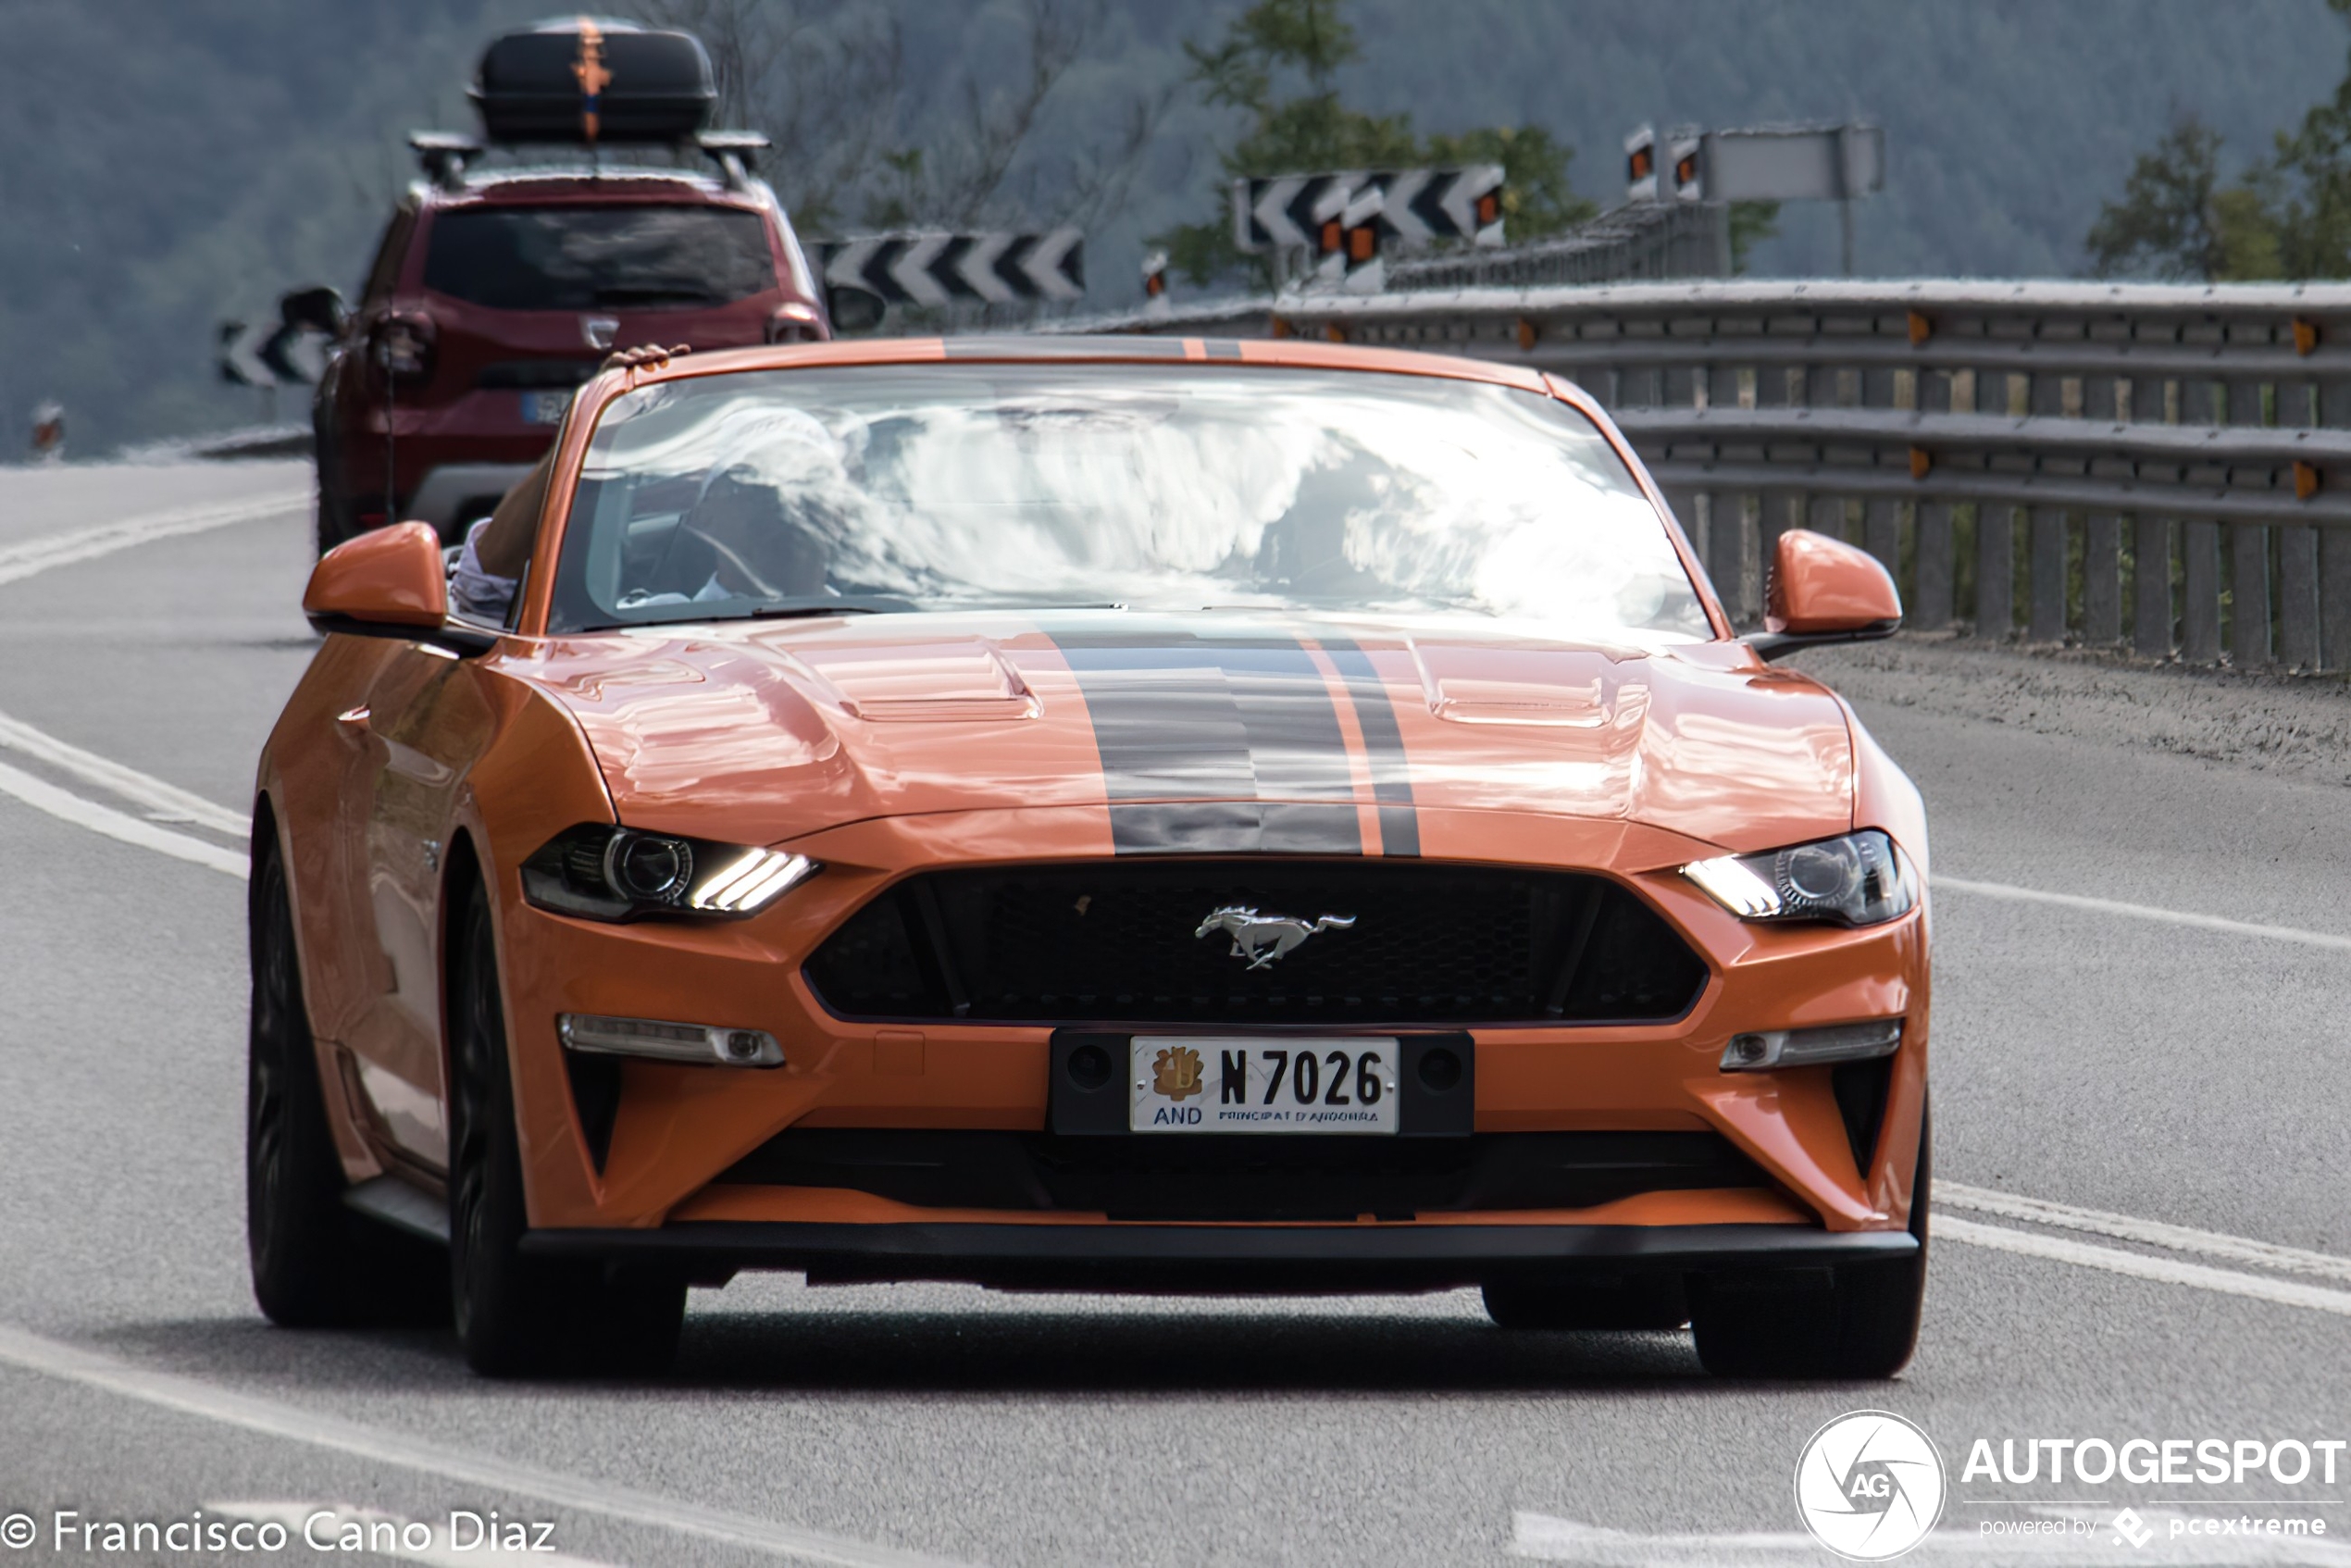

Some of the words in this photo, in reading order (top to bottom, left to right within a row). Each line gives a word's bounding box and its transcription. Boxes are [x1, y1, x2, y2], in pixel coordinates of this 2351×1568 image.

[1221, 1050, 1246, 1104] N
[1263, 1050, 1382, 1105] 7026
[1153, 1106, 1203, 1126] AND
